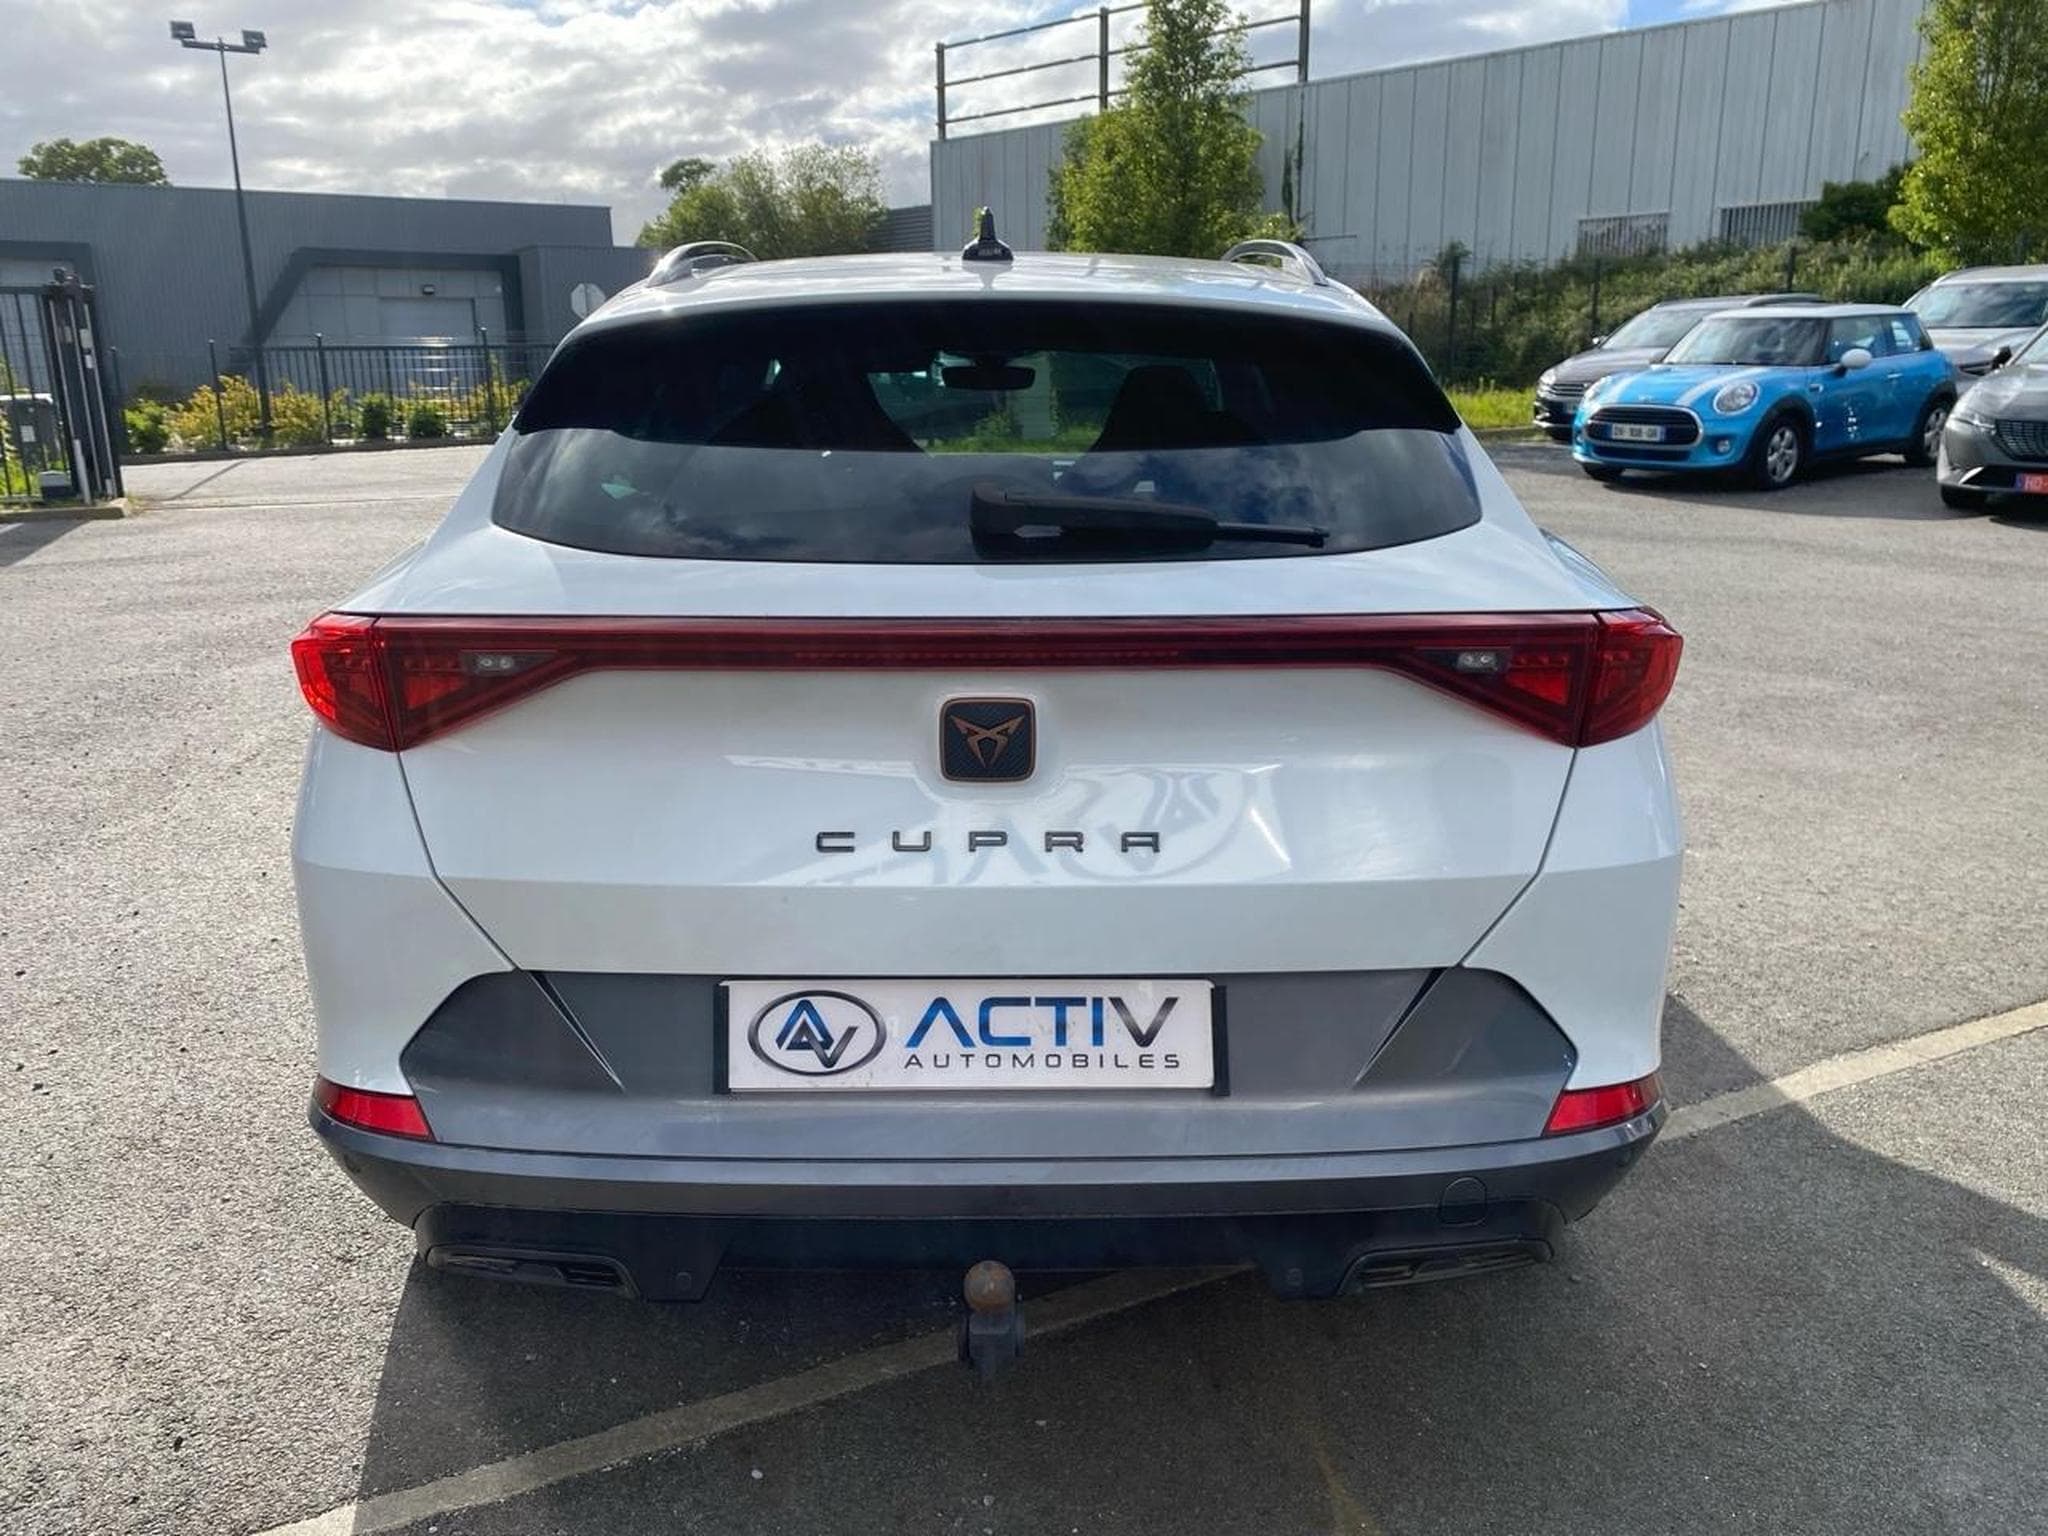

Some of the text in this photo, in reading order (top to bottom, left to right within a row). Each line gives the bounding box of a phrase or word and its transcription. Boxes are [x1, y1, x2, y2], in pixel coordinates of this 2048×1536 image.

[815, 830, 1161, 853] CUPRA
[905, 996, 1180, 1048] ACTIV
[903, 1053, 1180, 1070] AUTOMOBILES
